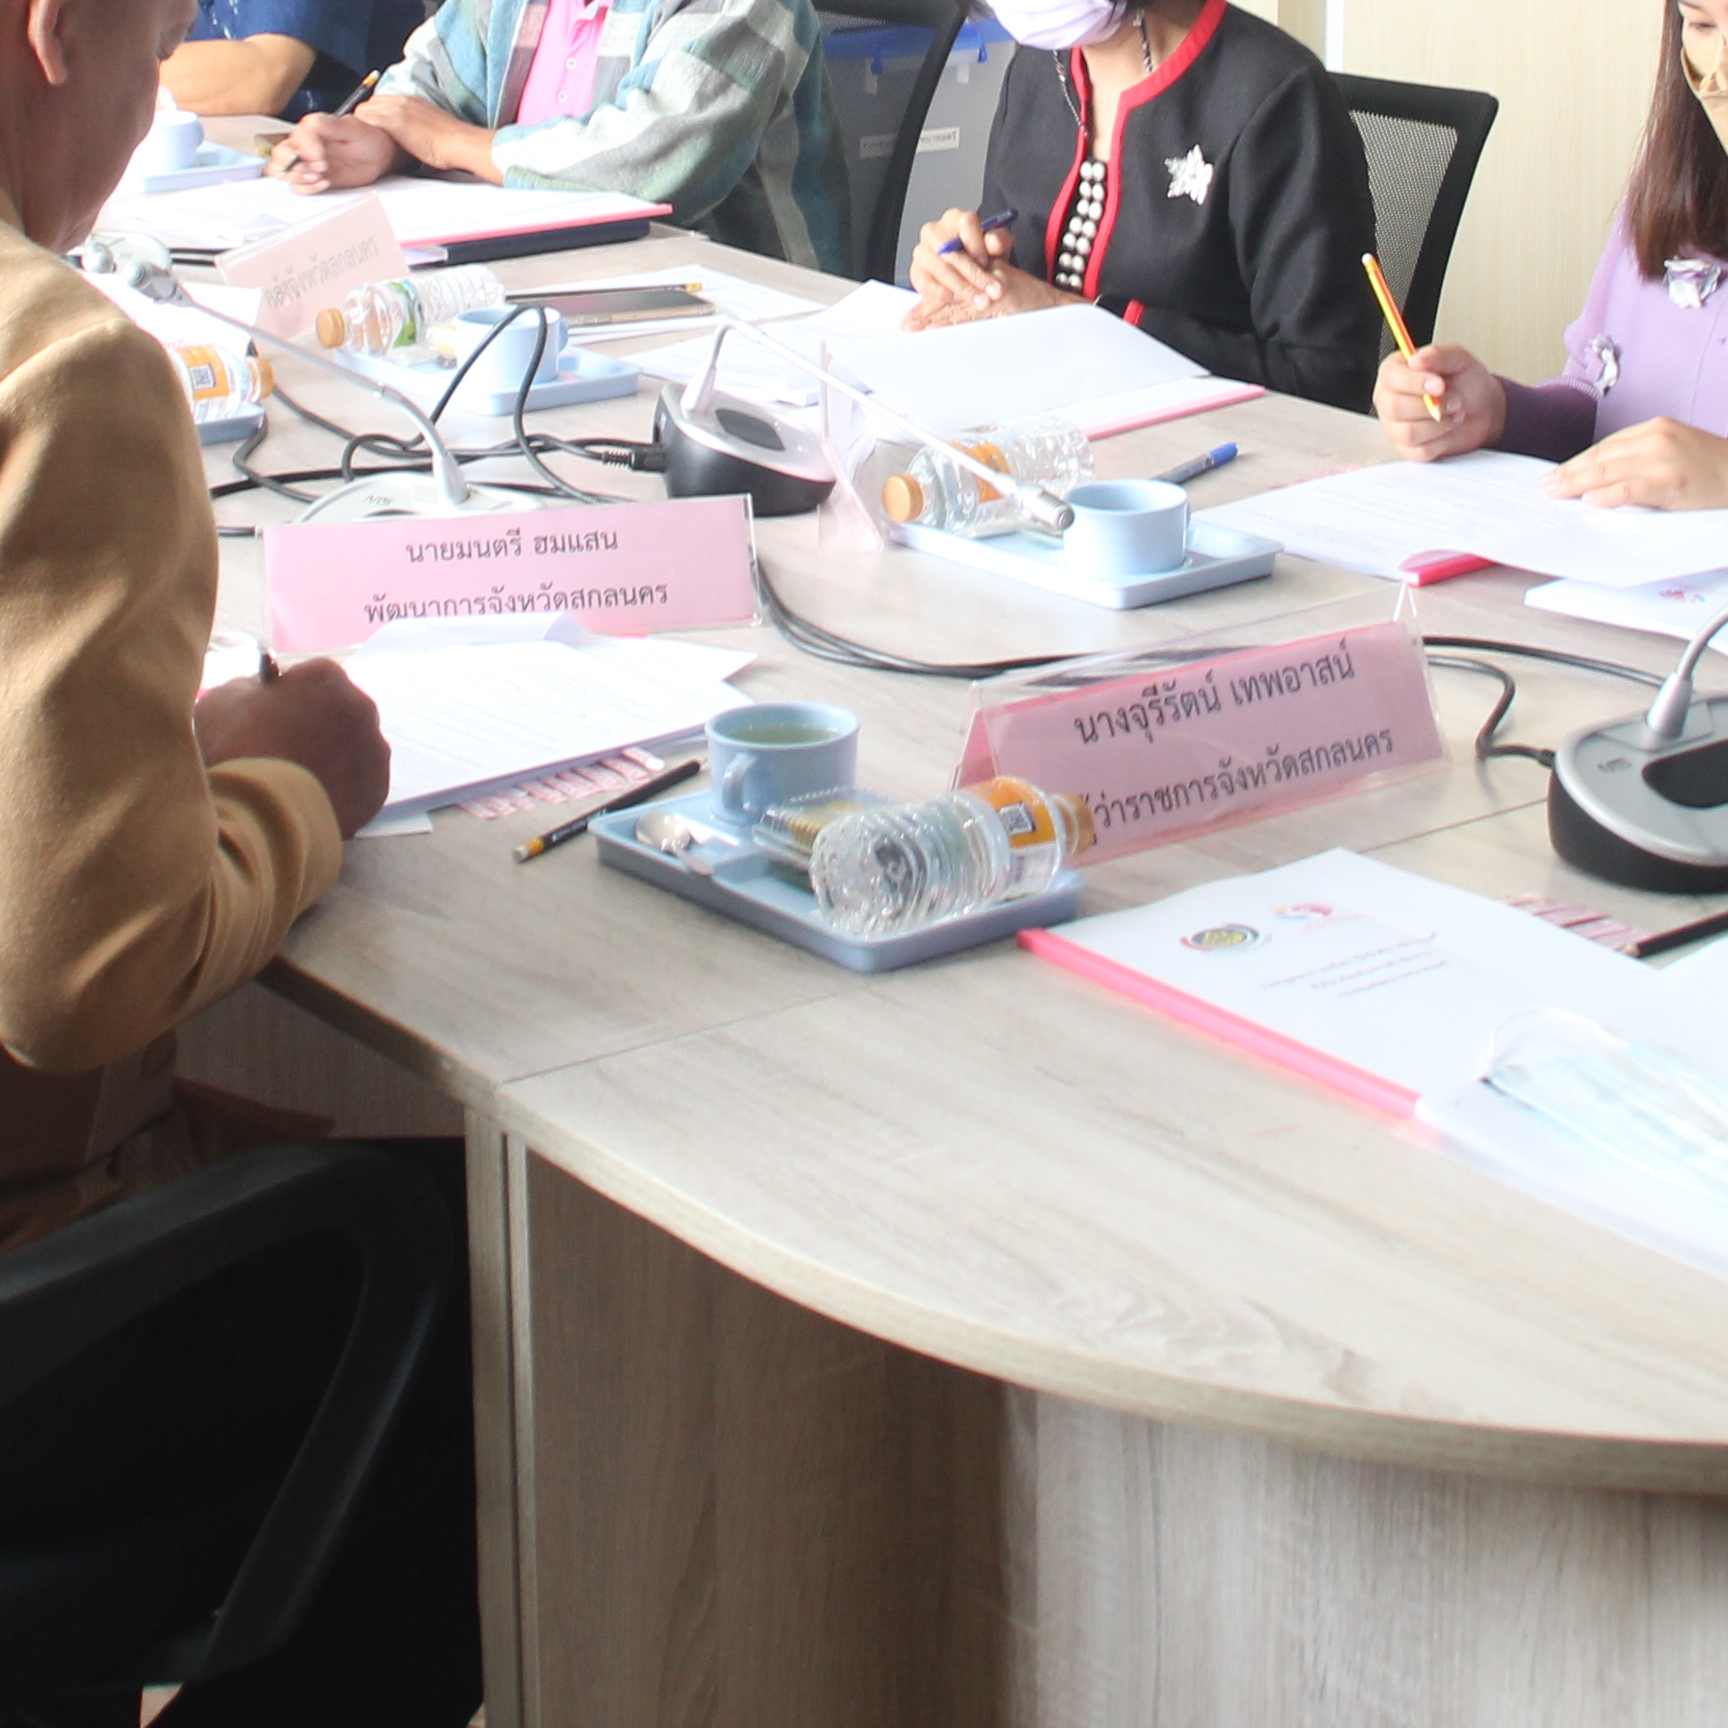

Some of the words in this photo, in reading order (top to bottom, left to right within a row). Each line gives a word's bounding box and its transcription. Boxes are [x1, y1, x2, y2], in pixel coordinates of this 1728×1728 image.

[405, 528, 522, 564] นายมนตรี
[534, 527, 619, 556] ฮมแสน
[363, 581, 668, 625] พัฒนาการจังหวัดสกลนคร
[1073, 668, 1222, 745] นางจุรีรัตน์
[1231, 636, 1355, 707] เทพอาสน์
